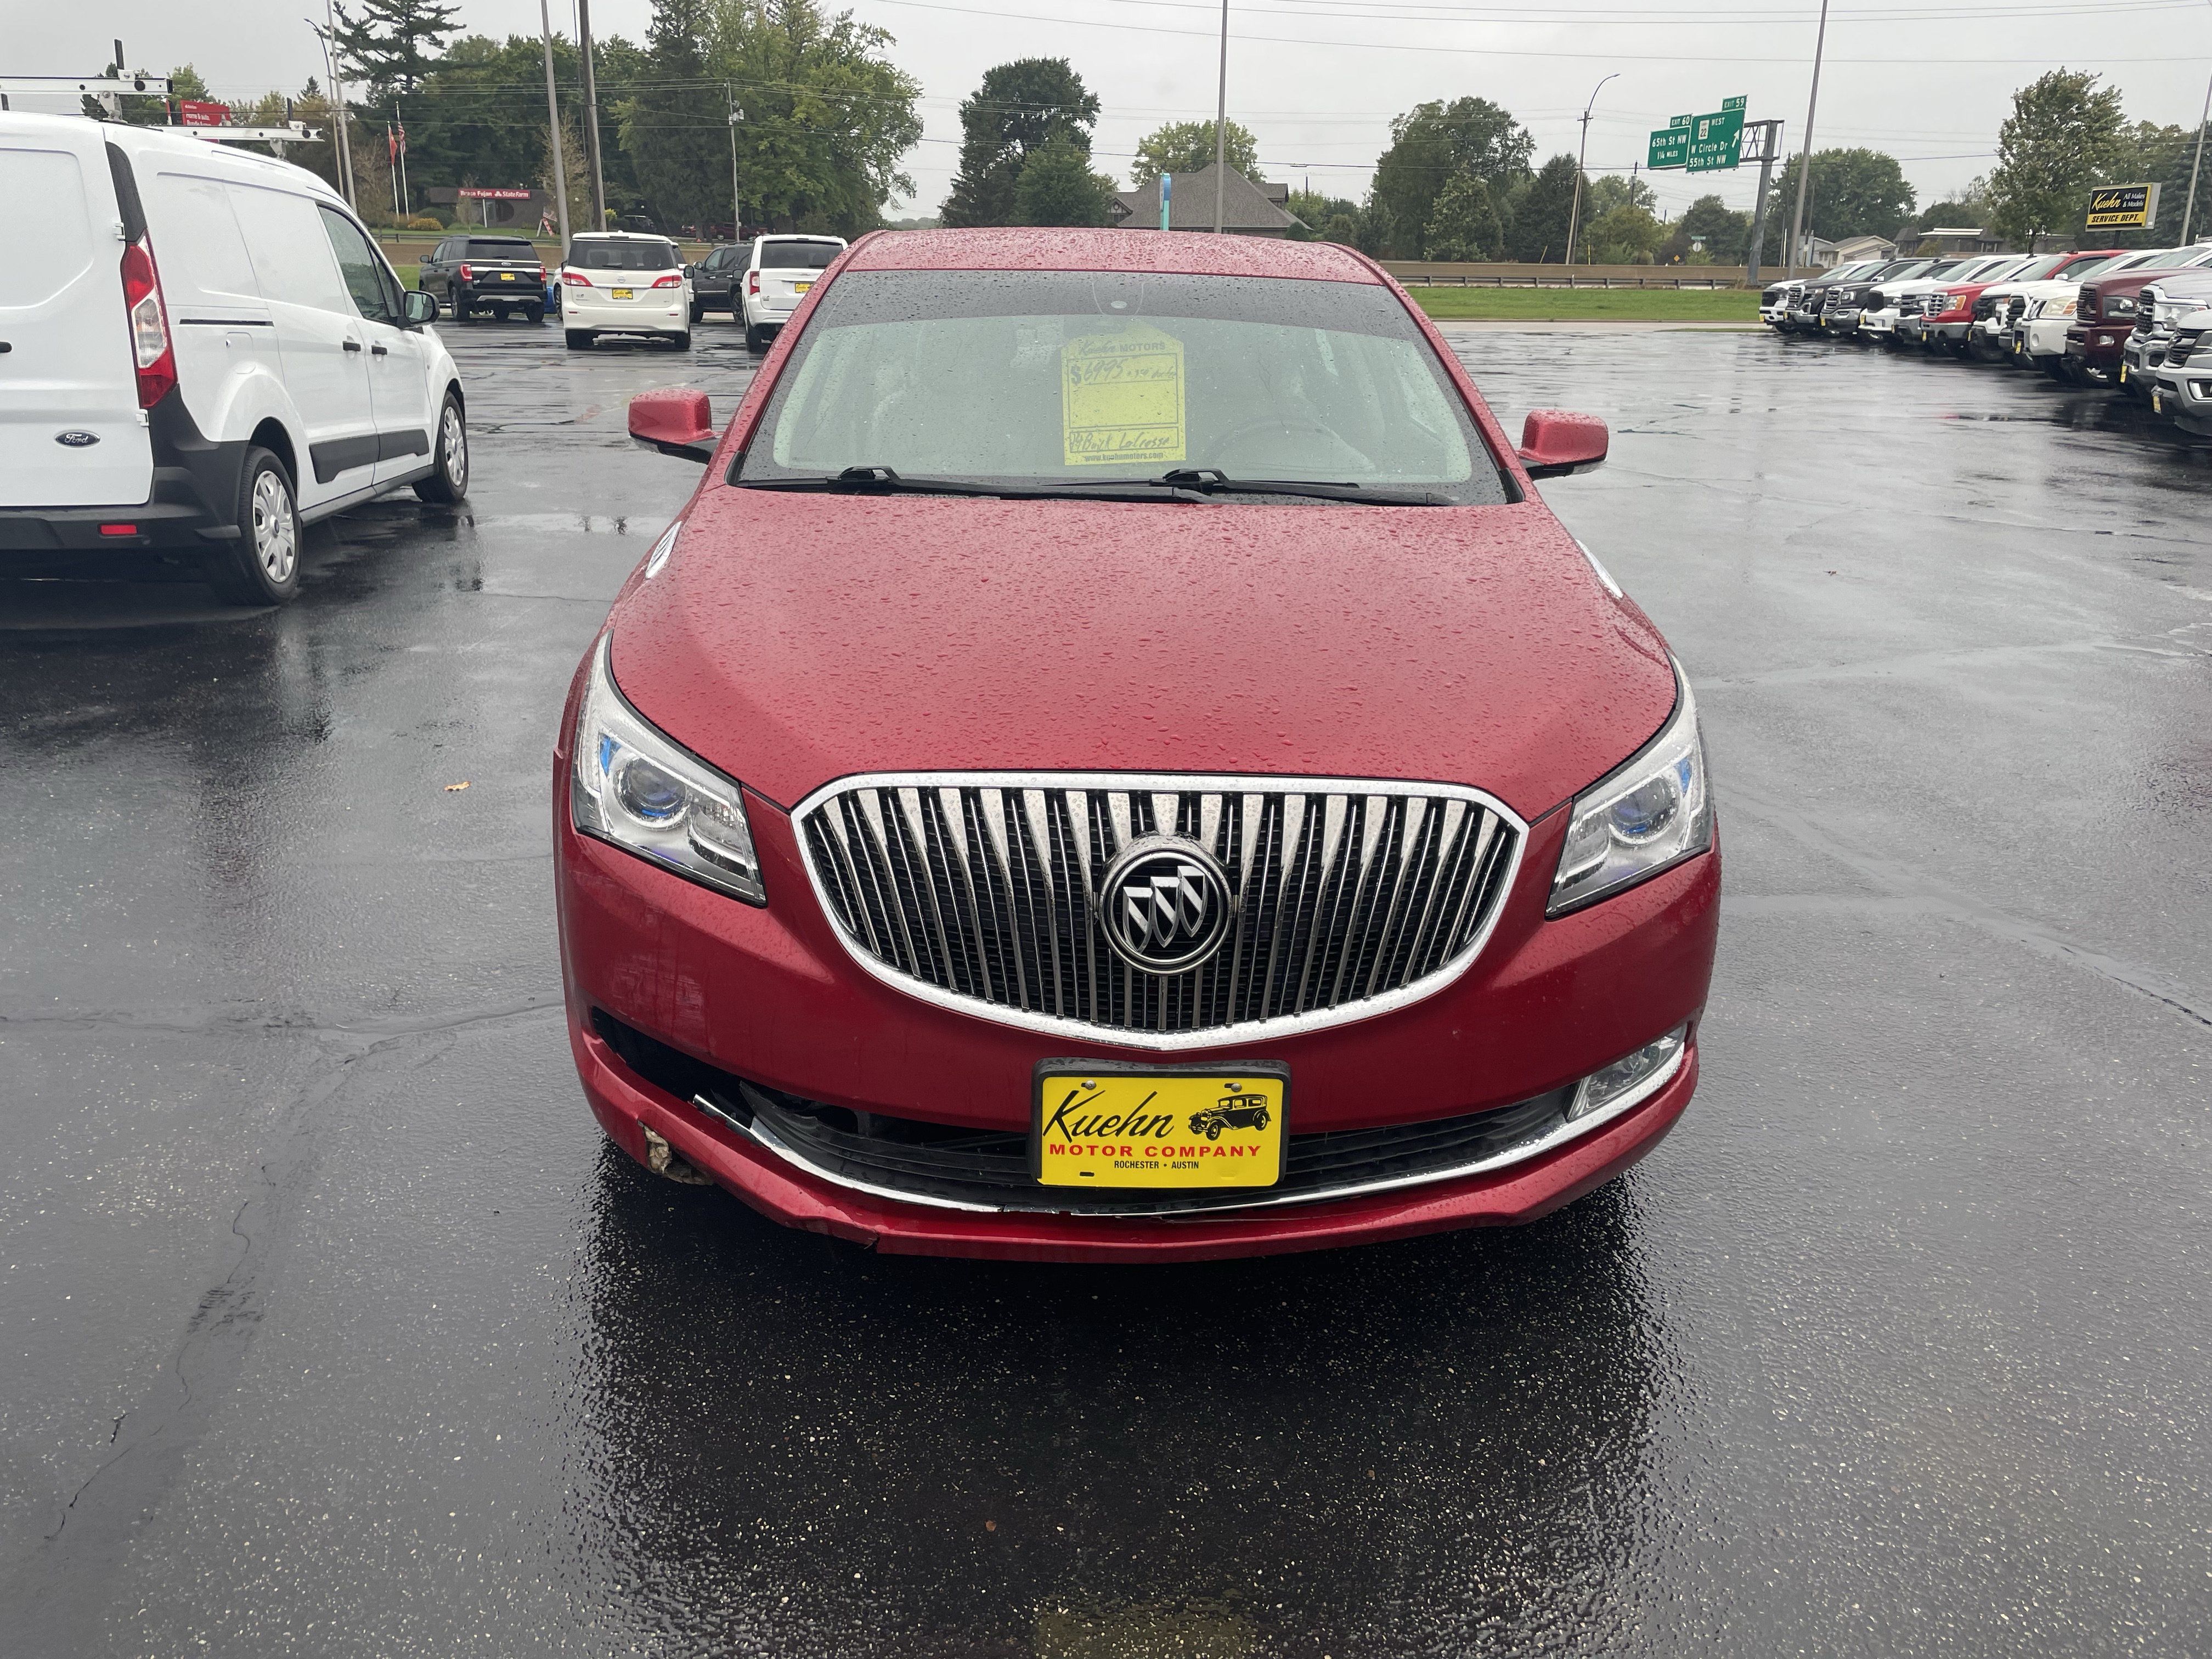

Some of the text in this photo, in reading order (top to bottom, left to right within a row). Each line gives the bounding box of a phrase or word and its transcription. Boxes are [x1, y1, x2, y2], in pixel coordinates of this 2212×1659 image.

[1735, 98, 1745, 108] 59
[1681, 116, 1690, 126] 60
[1711, 117, 1725, 126] WEST
[1700, 128, 1707, 137] 22
[1652, 134, 1687, 148] 65th St NW
[1691, 141, 1728, 154] W Circle Dr
[1689, 154, 1727, 167] 55th St NW
[2091, 191, 2121, 211] Kuehn
[2091, 213, 2139, 223] SERVICE DEPT.
[1120, 342, 1166, 352] MOTORS
[65, 433, 88, 443] Ford
[1042, 1090, 1175, 1143] Kuehn
[1049, 1143, 1262, 1158] MOTOR COMPANY
[1114, 1160, 1199, 1170] ROCHESTER AUSTIN
